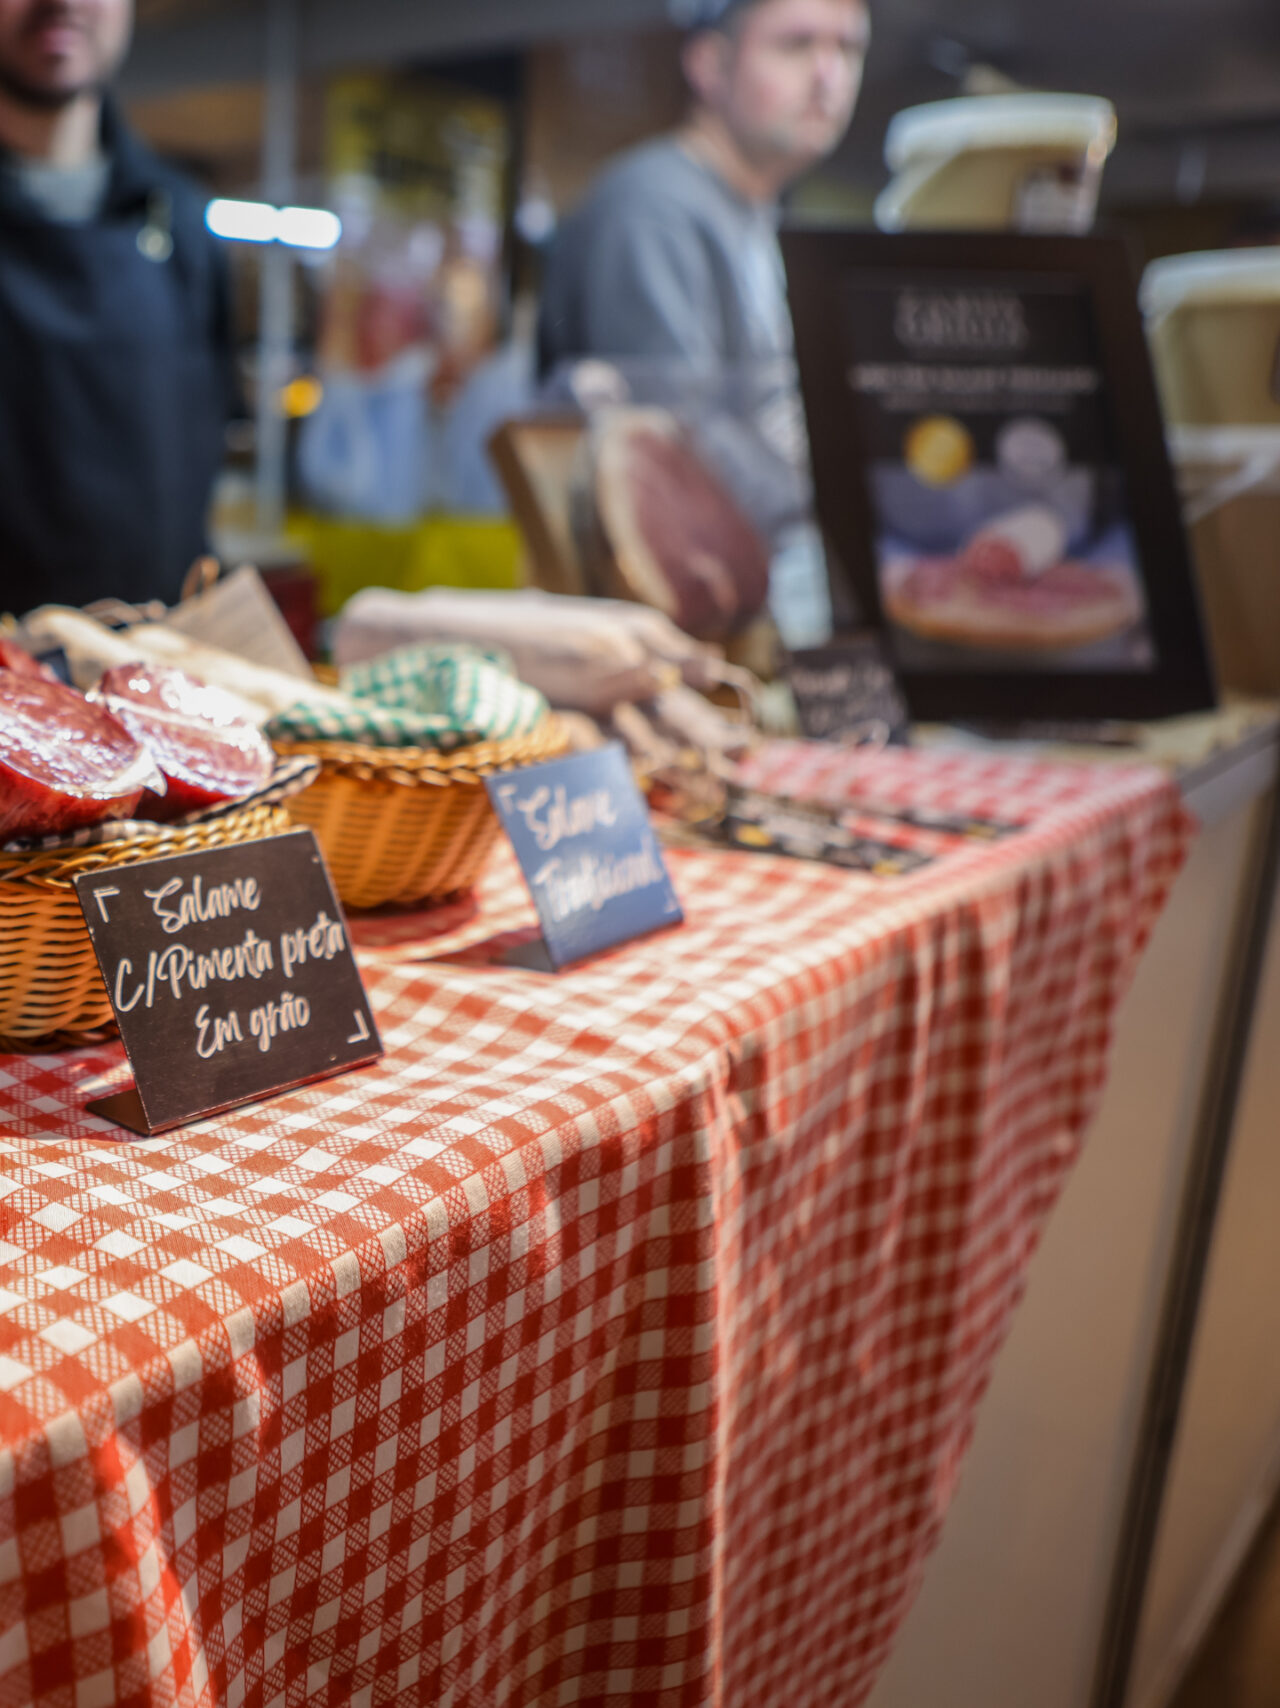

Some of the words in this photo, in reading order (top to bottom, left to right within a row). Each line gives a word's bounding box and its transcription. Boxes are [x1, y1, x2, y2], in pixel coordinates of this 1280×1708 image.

[143, 874, 261, 934] Salame
[281, 911, 345, 978] preta
[195, 1004, 244, 1059] Em
[250, 991, 310, 1052] grão
